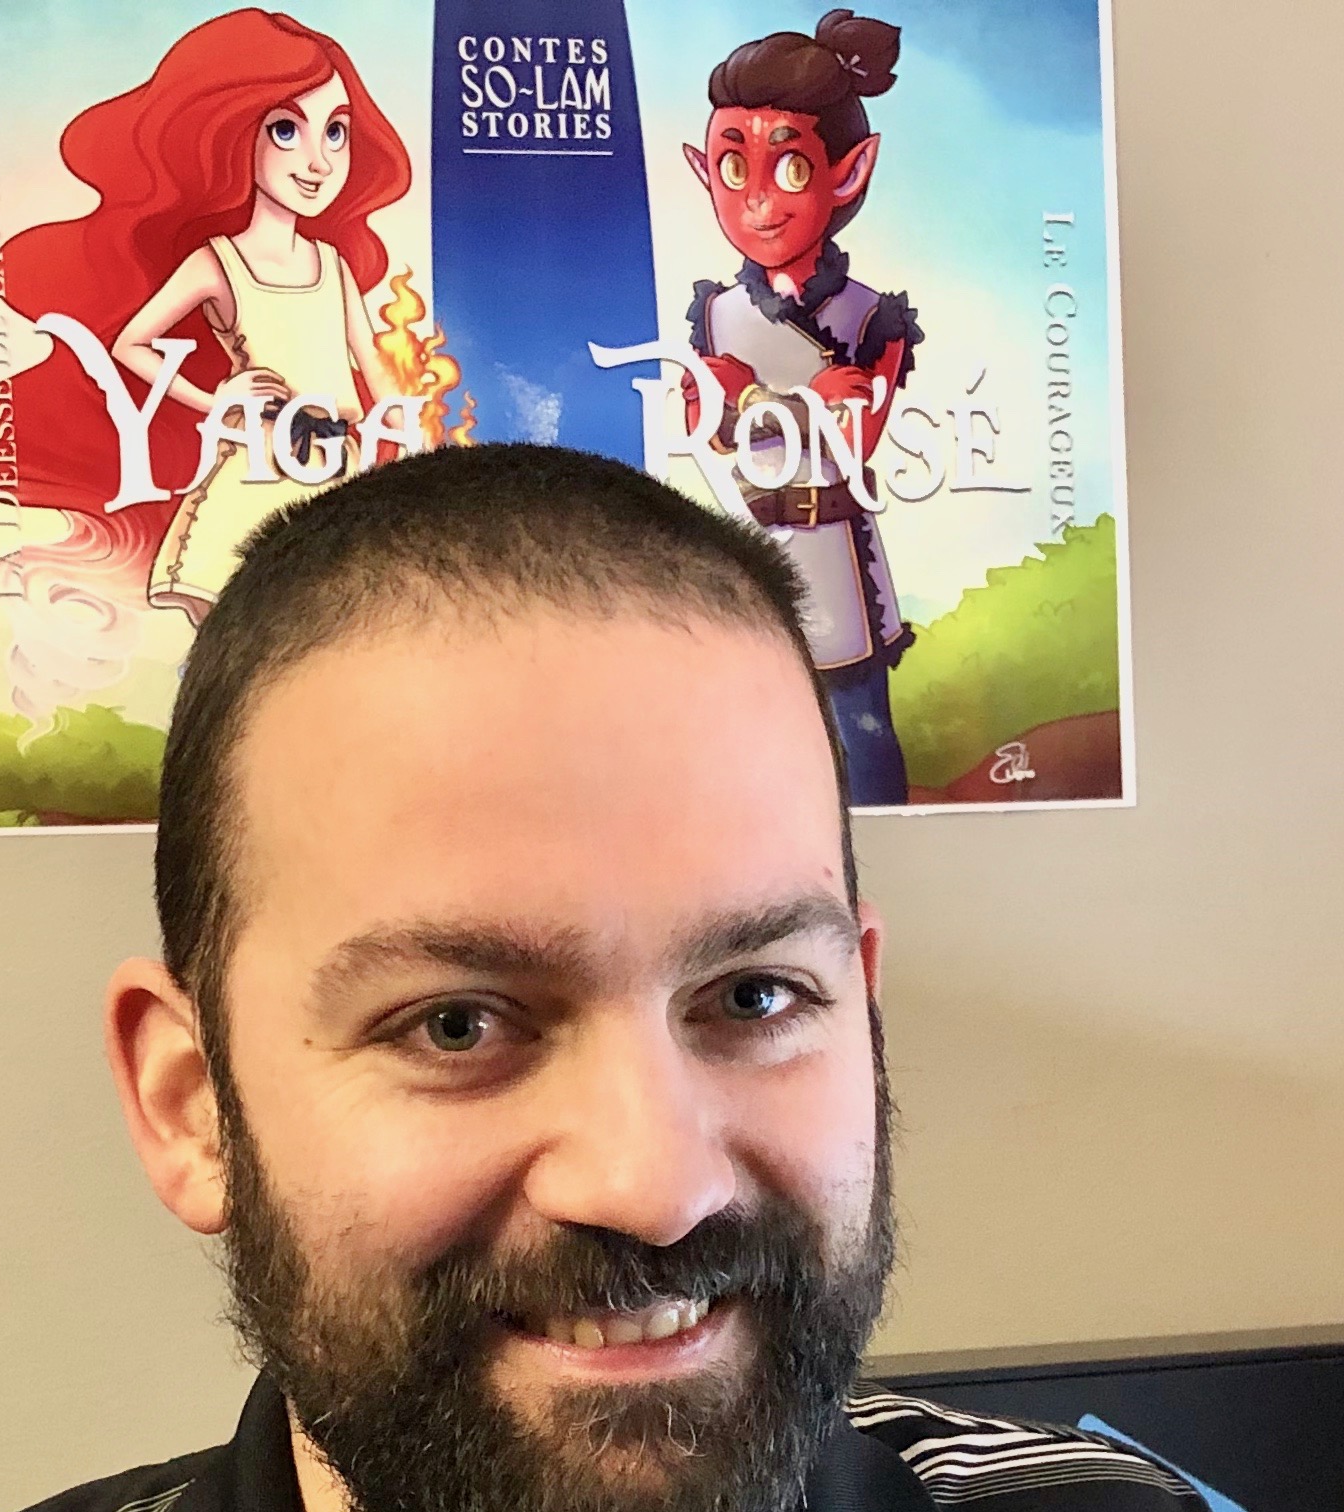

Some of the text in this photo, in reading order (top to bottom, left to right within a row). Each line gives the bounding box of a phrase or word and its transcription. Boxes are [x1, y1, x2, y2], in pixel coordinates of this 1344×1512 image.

[458, 35, 608, 65] CONTES
[461, 111, 613, 139] STORIES
[34, 312, 434, 514] YAGA
[1042, 210, 1078, 535] LE COURAGEUX
